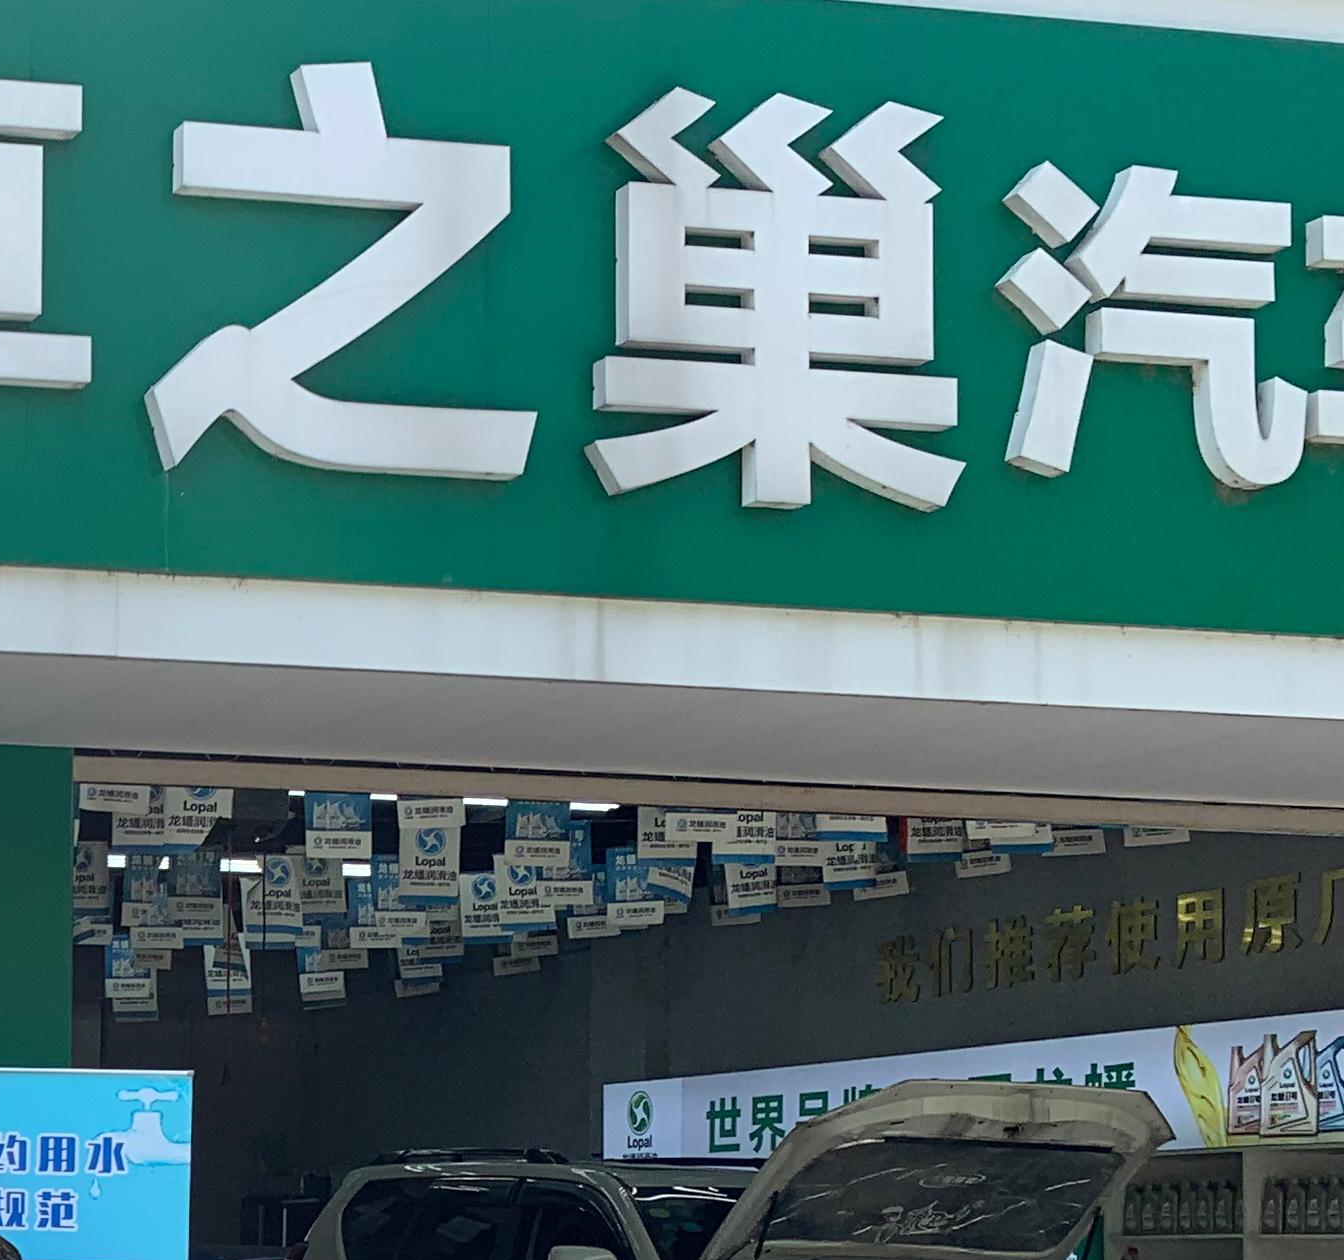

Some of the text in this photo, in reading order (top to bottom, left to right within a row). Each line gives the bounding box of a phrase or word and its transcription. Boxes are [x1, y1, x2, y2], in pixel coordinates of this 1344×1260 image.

[183, 800, 218, 814] Lopal
[738, 812, 763, 823] opal
[415, 855, 446, 868] Lopal
[740, 868, 768, 880] Lopal
[302, 877, 331, 890] Lopal
[509, 886, 538, 897] Lopal
[473, 902, 499, 912] Lopal
[627, 1134, 653, 1150] Lopal
